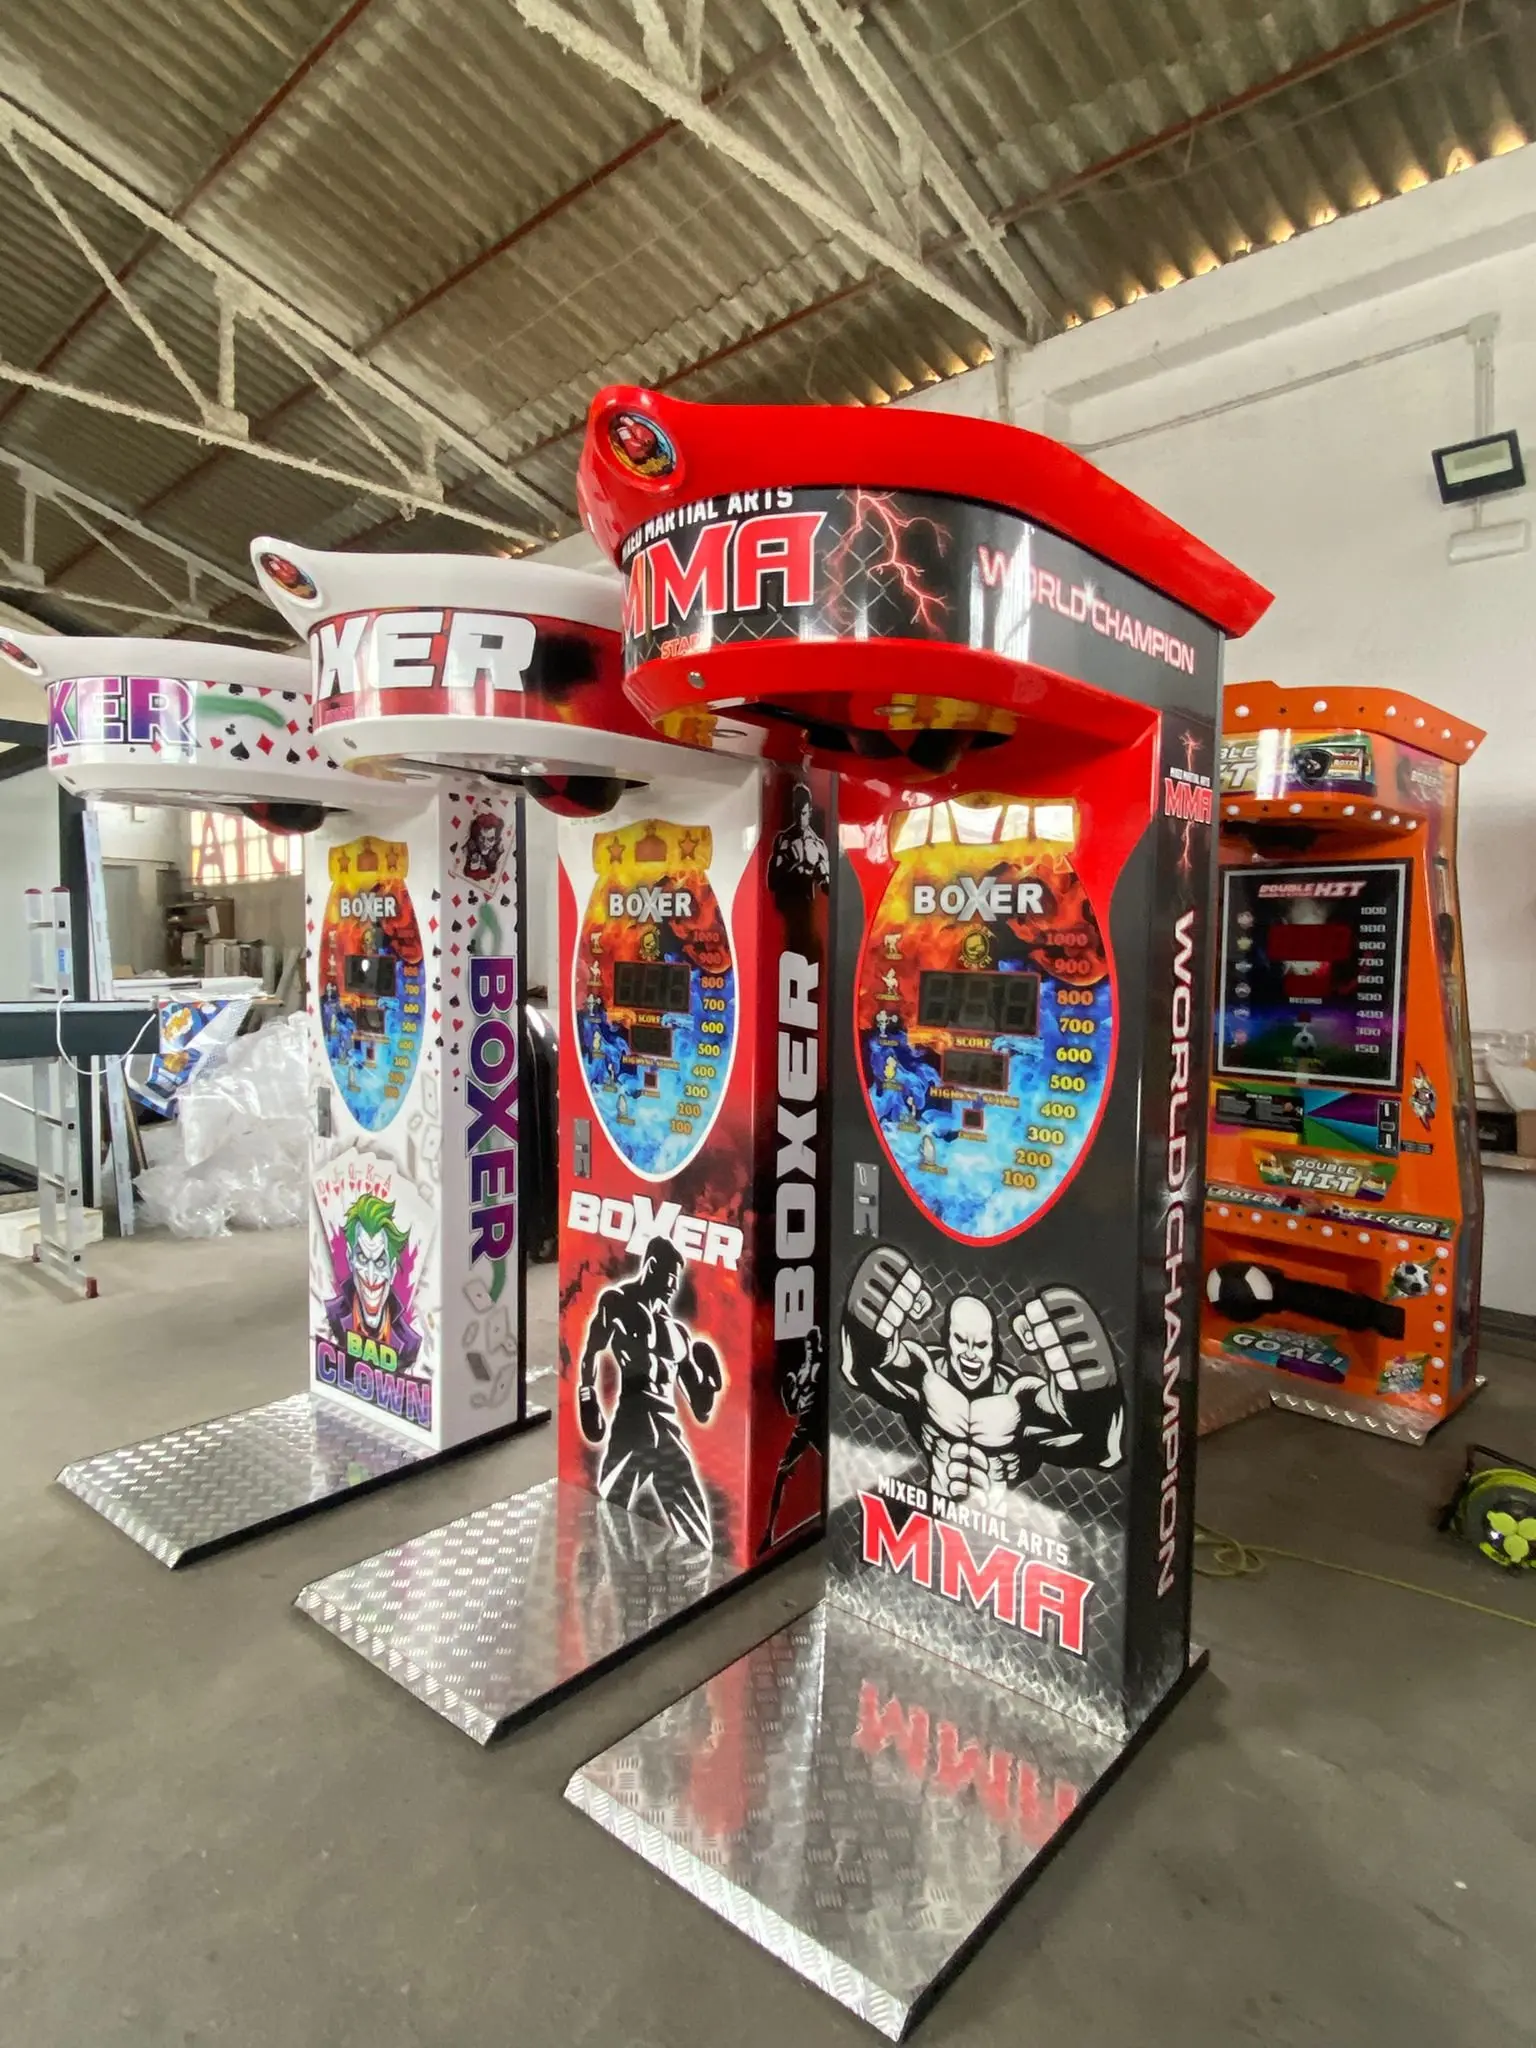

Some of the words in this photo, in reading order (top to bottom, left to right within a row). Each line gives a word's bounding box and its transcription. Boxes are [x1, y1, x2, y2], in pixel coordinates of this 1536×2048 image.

[644, 497, 719, 543] MARTIAL
[727, 486, 793, 516] ARTS
[978, 546, 1088, 623] WRLD
[1089, 596, 1196, 676] CHAMPION
[309, 611, 537, 703] XER
[1164, 777, 1213, 825] MMA
[340, 892, 397, 922] BOXER
[609, 887, 692, 923] BOXER
[913, 876, 1044, 922] BOXER
[1045, 932, 1088, 948] 1000
[1054, 959, 1091, 974] 900
[701, 976, 724, 989] 800
[703, 999, 725, 1012] 700
[1057, 990, 1094, 1005] 800
[701, 1021, 724, 1034] 600
[1059, 1018, 1095, 1034] 700
[697, 1043, 721, 1057] 500
[955, 1036, 992, 1048] SCORE
[1056, 1048, 1093, 1062] 600
[1163, 909, 1195, 1196] WORLD
[692, 1066, 716, 1079] 400
[685, 1085, 708, 1099] 300
[1050, 1075, 1086, 1091] 500
[467, 956, 519, 1270] BOXER
[1040, 1103, 1077, 1119] 400
[774, 950, 820, 1341] BOXER
[1028, 1127, 1065, 1145] 300
[1016, 1151, 1053, 1168] 200
[1295, 1158, 1357, 1175] DOUBLE
[1003, 1171, 1037, 1189] 100
[1291, 1169, 1356, 1192] HIT
[567, 1190, 744, 1271] BOXER
[346, 1329, 398, 1372] BAD
[1232, 1333, 1344, 1368] GOAL!
[316, 1340, 432, 1428] CLOWN
[1157, 1197, 1187, 1599] CHAMPION
[877, 1475, 928, 1511] MIXED
[932, 1494, 1010, 1543] MARTIAL
[1016, 1532, 1070, 1566] ARTS
[857, 1489, 1095, 1656] MMA
